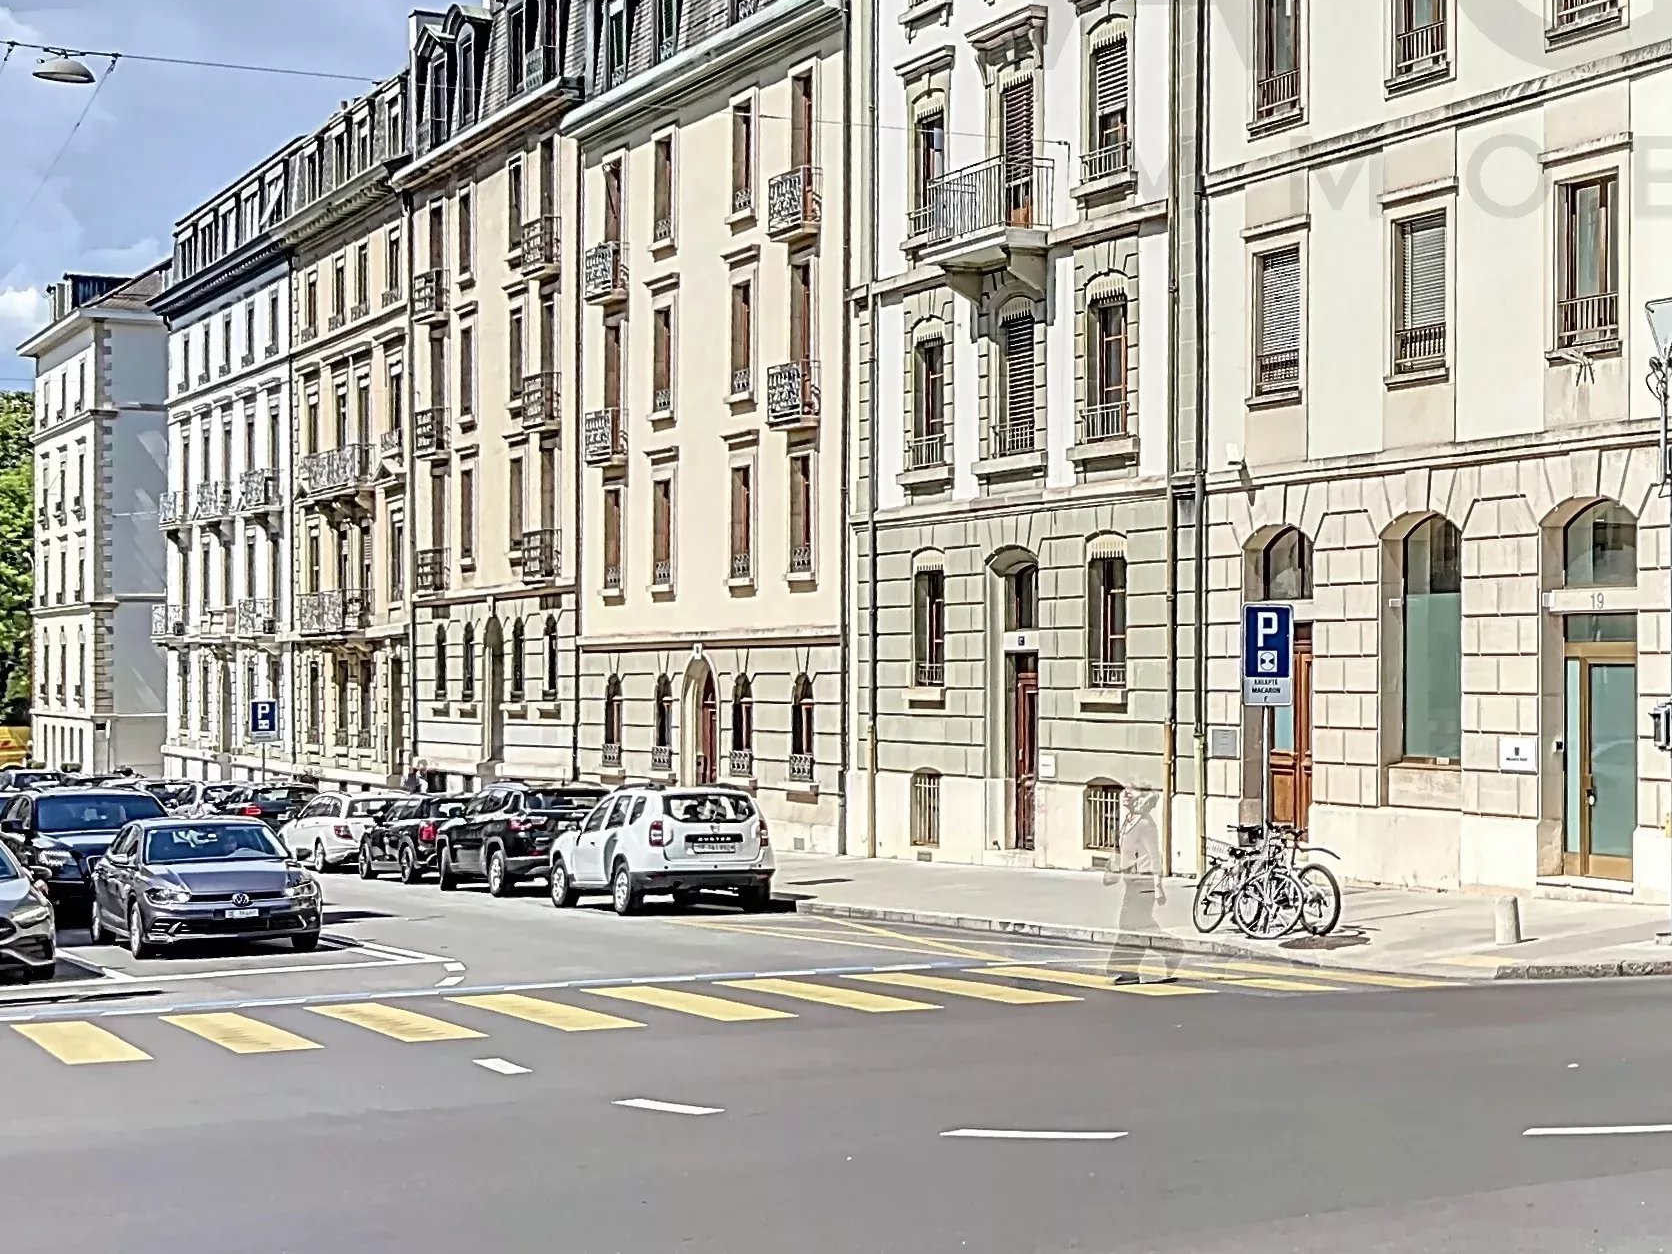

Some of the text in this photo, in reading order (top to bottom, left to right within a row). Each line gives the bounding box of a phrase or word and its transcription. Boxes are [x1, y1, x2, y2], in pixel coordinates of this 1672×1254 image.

[1590, 592, 1605, 610] 19
[1257, 612, 1278, 647] P
[257, 703, 270, 719] P
